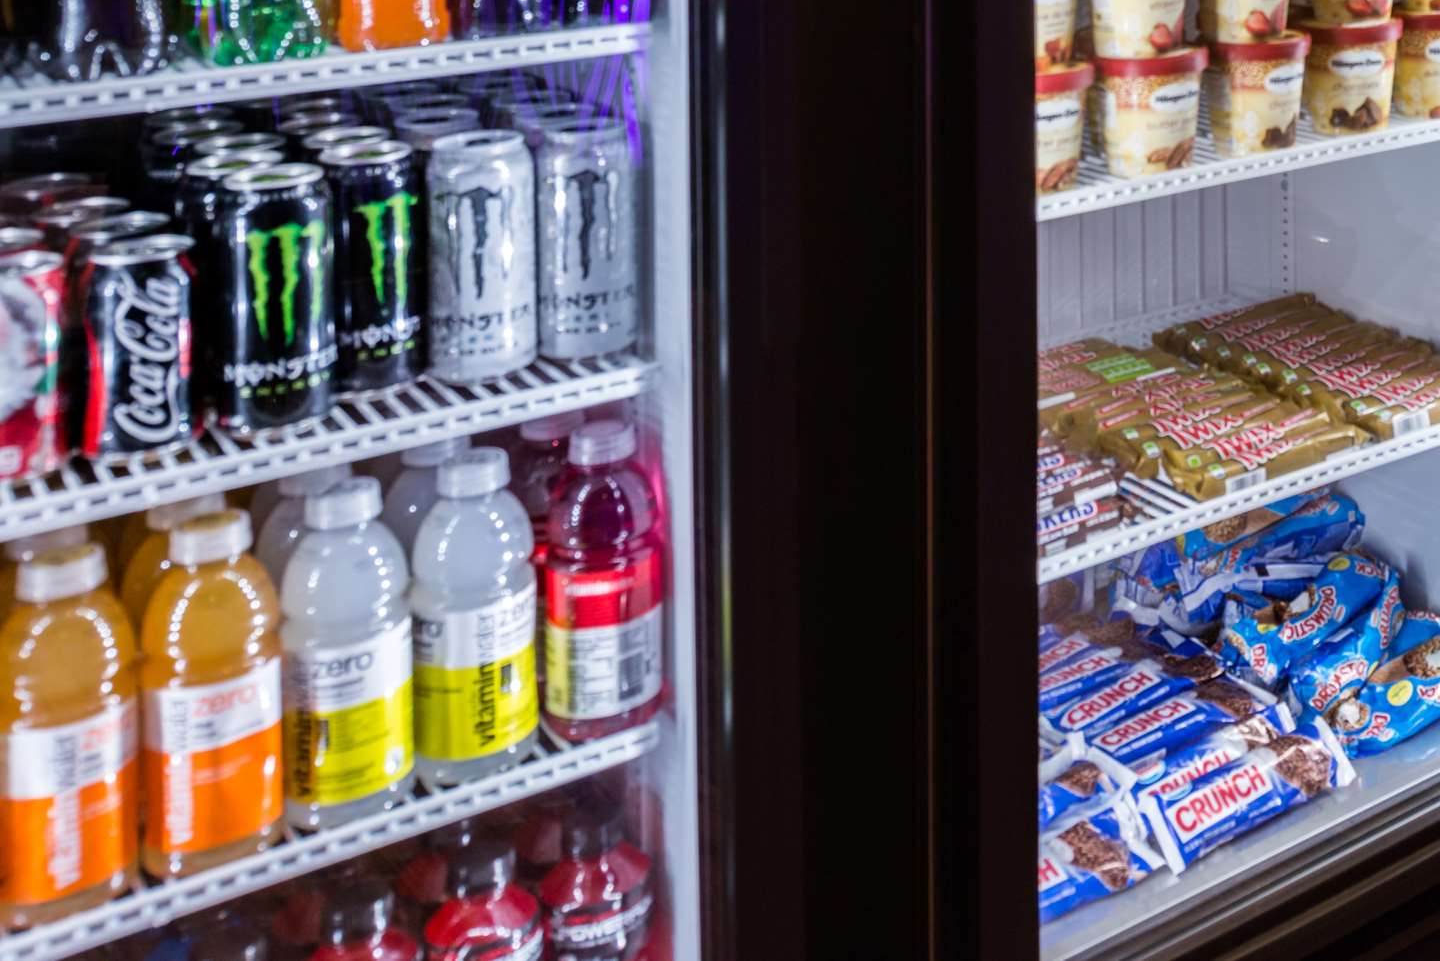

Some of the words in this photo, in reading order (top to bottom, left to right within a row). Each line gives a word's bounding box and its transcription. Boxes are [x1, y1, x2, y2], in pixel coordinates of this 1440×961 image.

[114, 275, 180, 443] Coca-Cola
[1170, 414, 1243, 450] TWIX
[1215, 421, 1285, 460] TWIX
[314, 649, 374, 679] zero
[1038, 655, 1110, 691] RUNCH
[1066, 671, 1154, 728] CRUNCH
[1099, 701, 1188, 746] CRUNCH
[1174, 767, 1267, 834] CRUNCH
